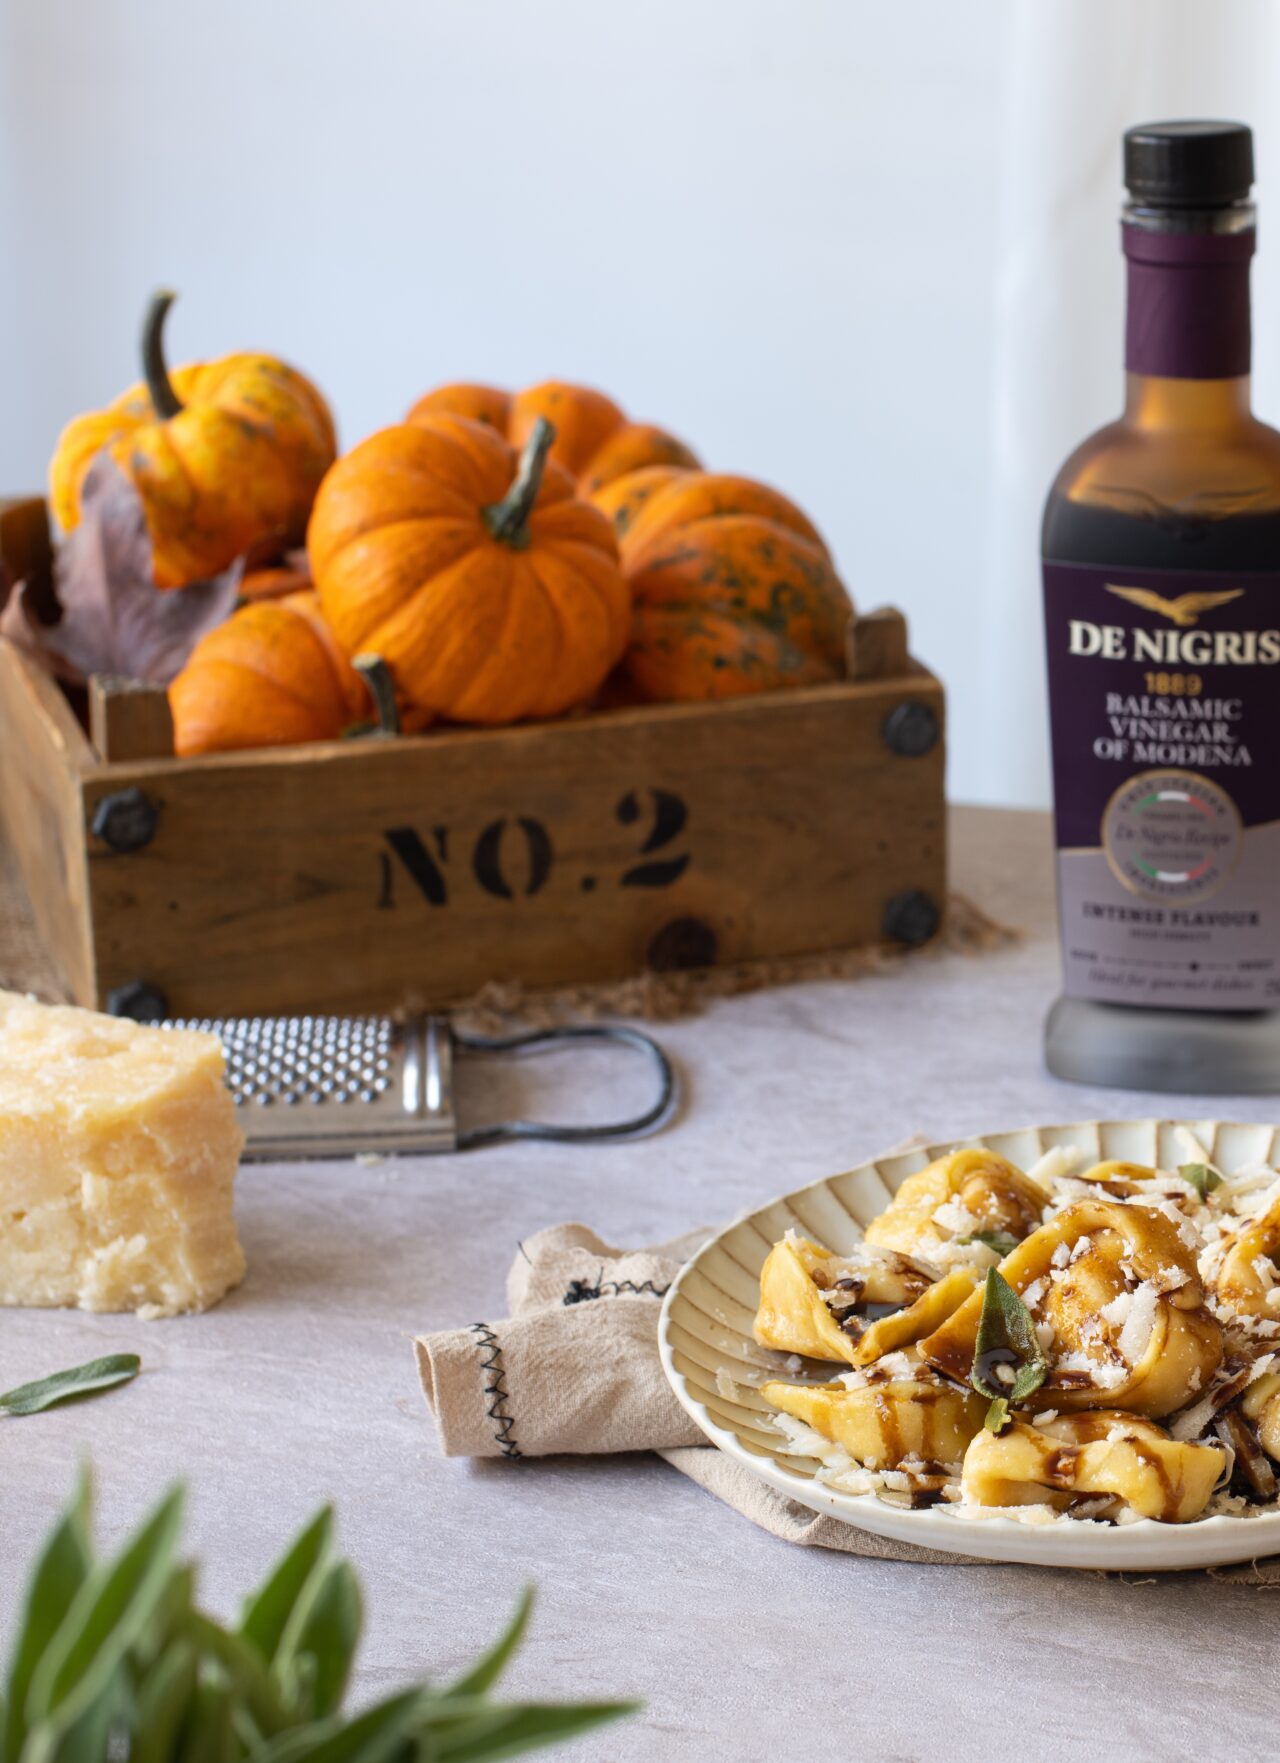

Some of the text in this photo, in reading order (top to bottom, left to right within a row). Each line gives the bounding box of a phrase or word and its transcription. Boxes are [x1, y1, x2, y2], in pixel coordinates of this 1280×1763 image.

[1069, 619, 1127, 660] DE
[1105, 692, 1242, 720] BALSAMIC
[1109, 717, 1238, 743] VINEGAR
[1092, 737, 1253, 767] OF MODENA
[1082, 902, 1260, 927] INTENSE FLAVOUR
